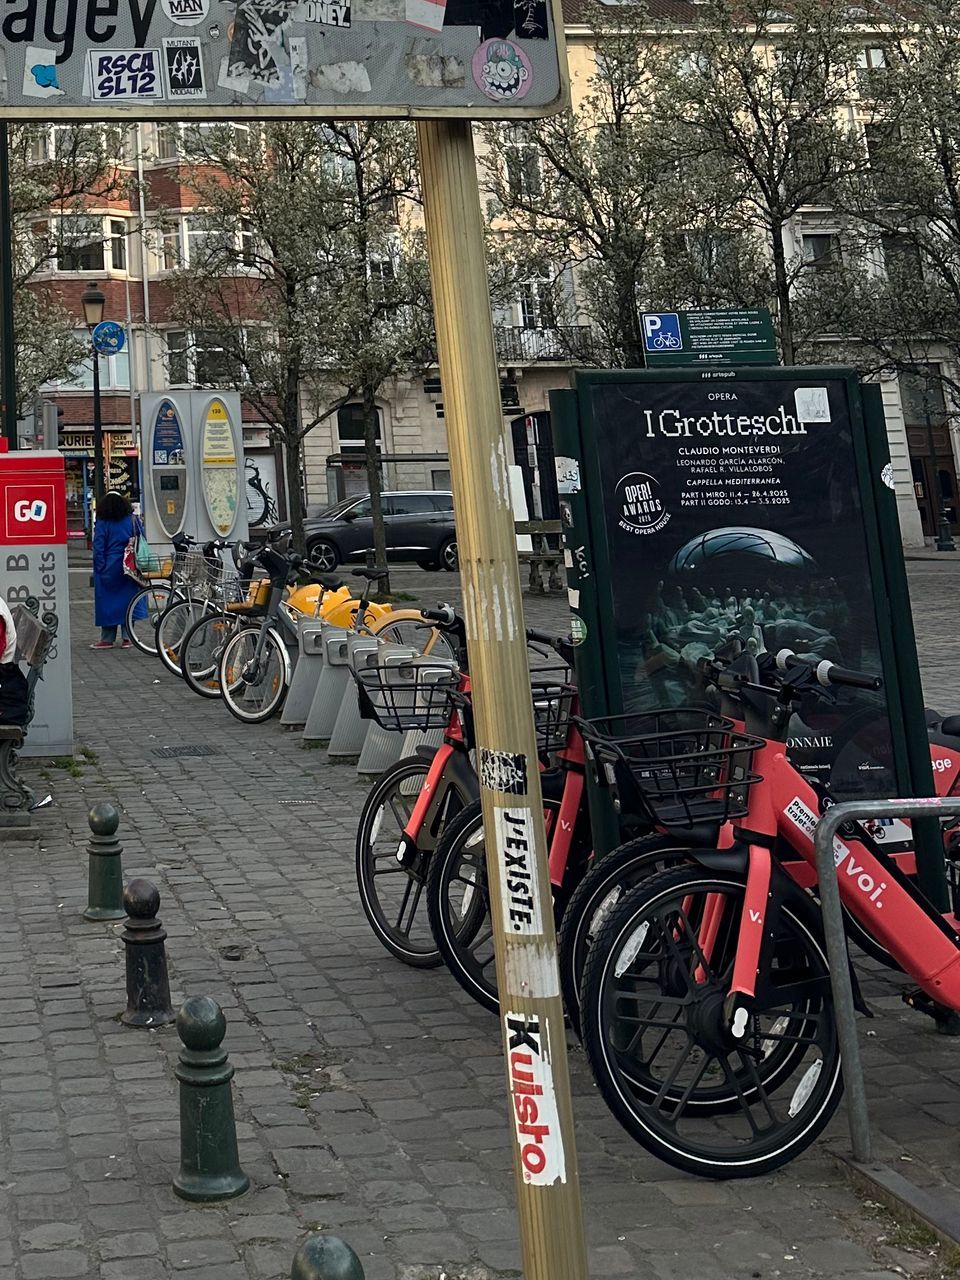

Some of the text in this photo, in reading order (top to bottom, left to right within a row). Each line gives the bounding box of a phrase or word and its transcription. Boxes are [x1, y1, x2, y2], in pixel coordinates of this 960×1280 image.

[166, 39, 196, 47] MUTANT
[97, 51, 155, 77] RSCA
[97, 73, 156, 98] SL12
[170, 88, 204, 96] MODALITY
[644, 315, 662, 338] P
[707, 392, 738, 401] OPERA
[643, 410, 656, 438] I
[678, 445, 781, 456] CLAUDIO MONTEVERDI
[676, 458, 717, 467] LEONARDO
[728, 464, 773, 473] VILLALOBOS
[725, 477, 781, 486] MEDITERRANEA
[624, 480, 653, 503] OPER!
[681, 491, 699, 499] PART
[622, 498, 662, 517] AWARDS
[680, 499, 699, 507] PART
[707, 498, 733, 506] GODO:
[14, 500, 47, 522] GO
[618, 520, 634, 532] BEST
[634, 526, 657, 535] OPERA
[785, 735, 834, 749] ONNAIE
[503, 811, 534, 932] J'EXISTE.
[845, 856, 887, 909] voi.
[748, 908, 763, 925] v.
